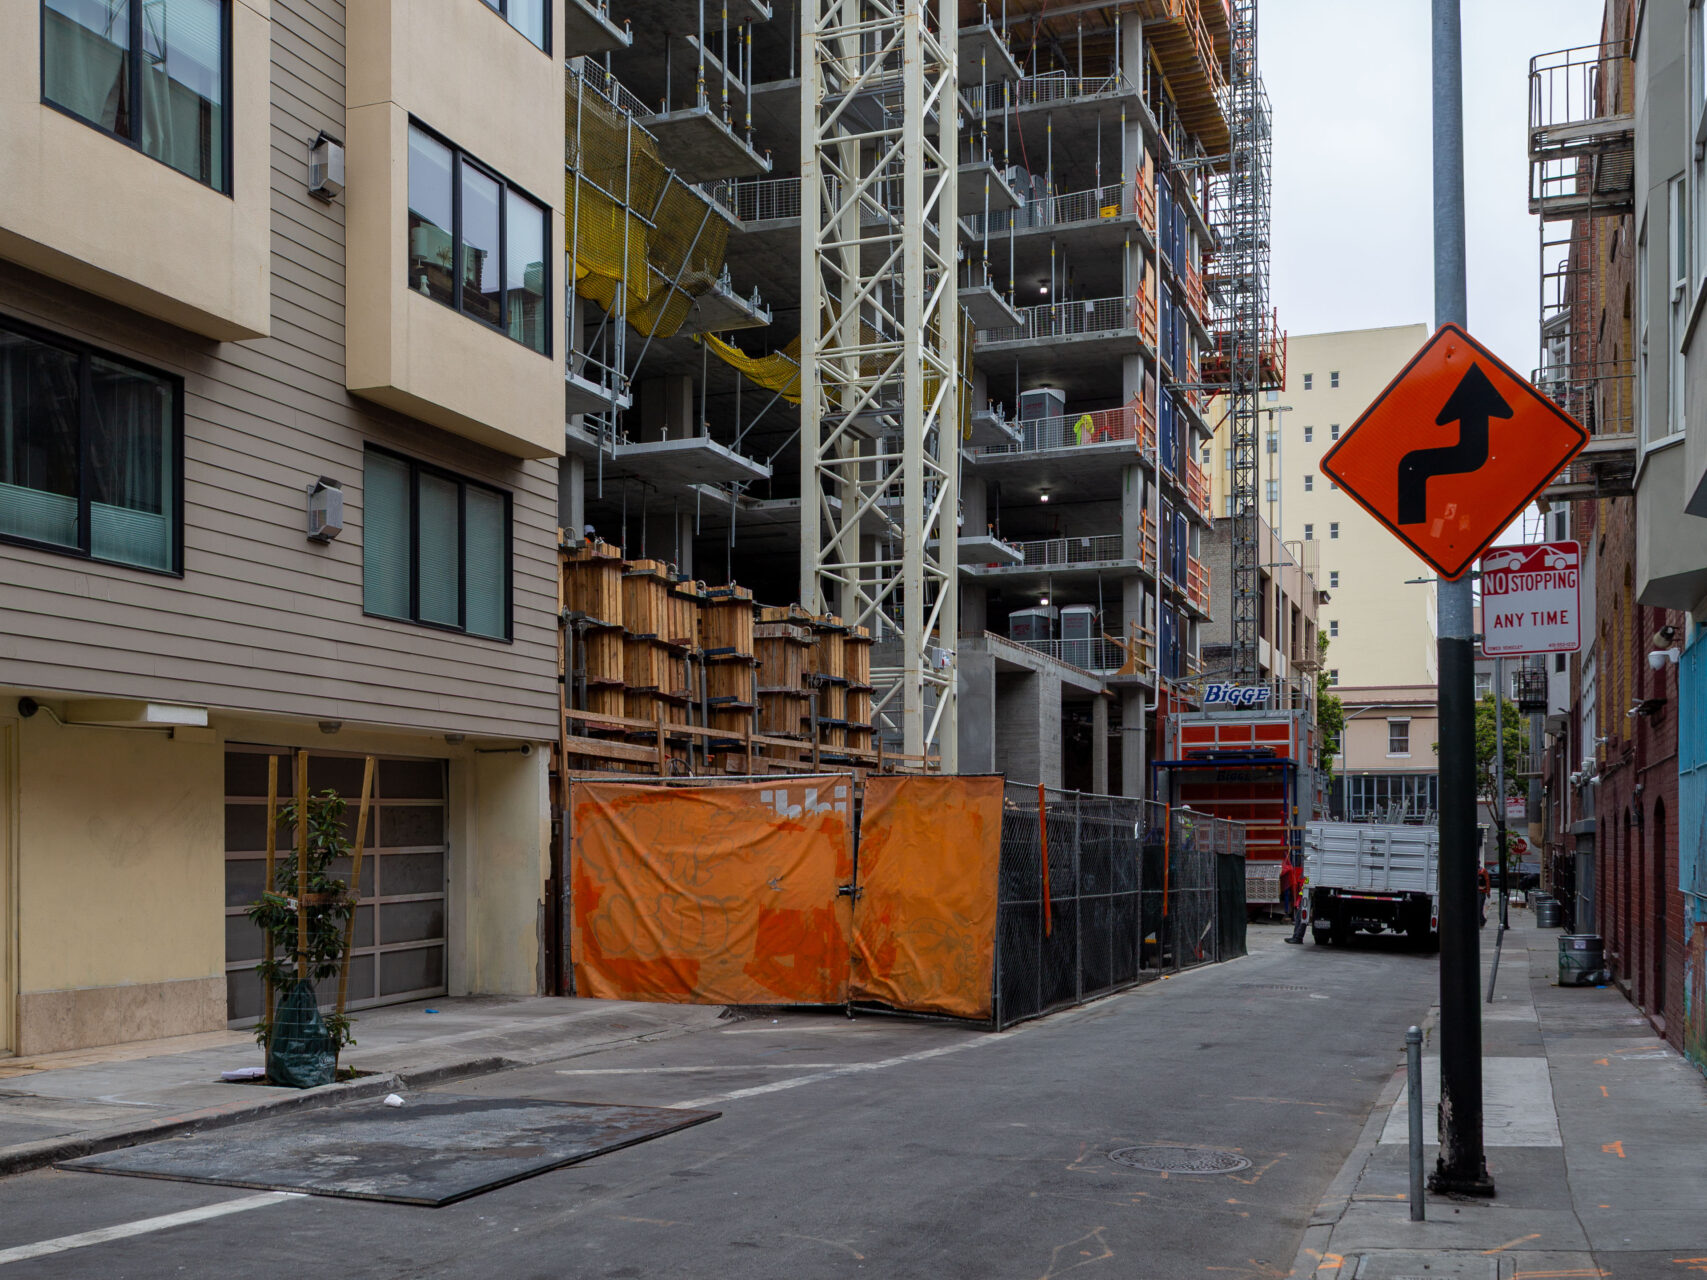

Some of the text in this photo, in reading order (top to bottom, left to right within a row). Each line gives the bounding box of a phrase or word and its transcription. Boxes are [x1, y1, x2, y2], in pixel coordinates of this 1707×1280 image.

[1484, 571, 1576, 594] NO STOPPING
[1493, 609, 1569, 629] ANY TIME
[1204, 684, 1270, 705] BIGGE
